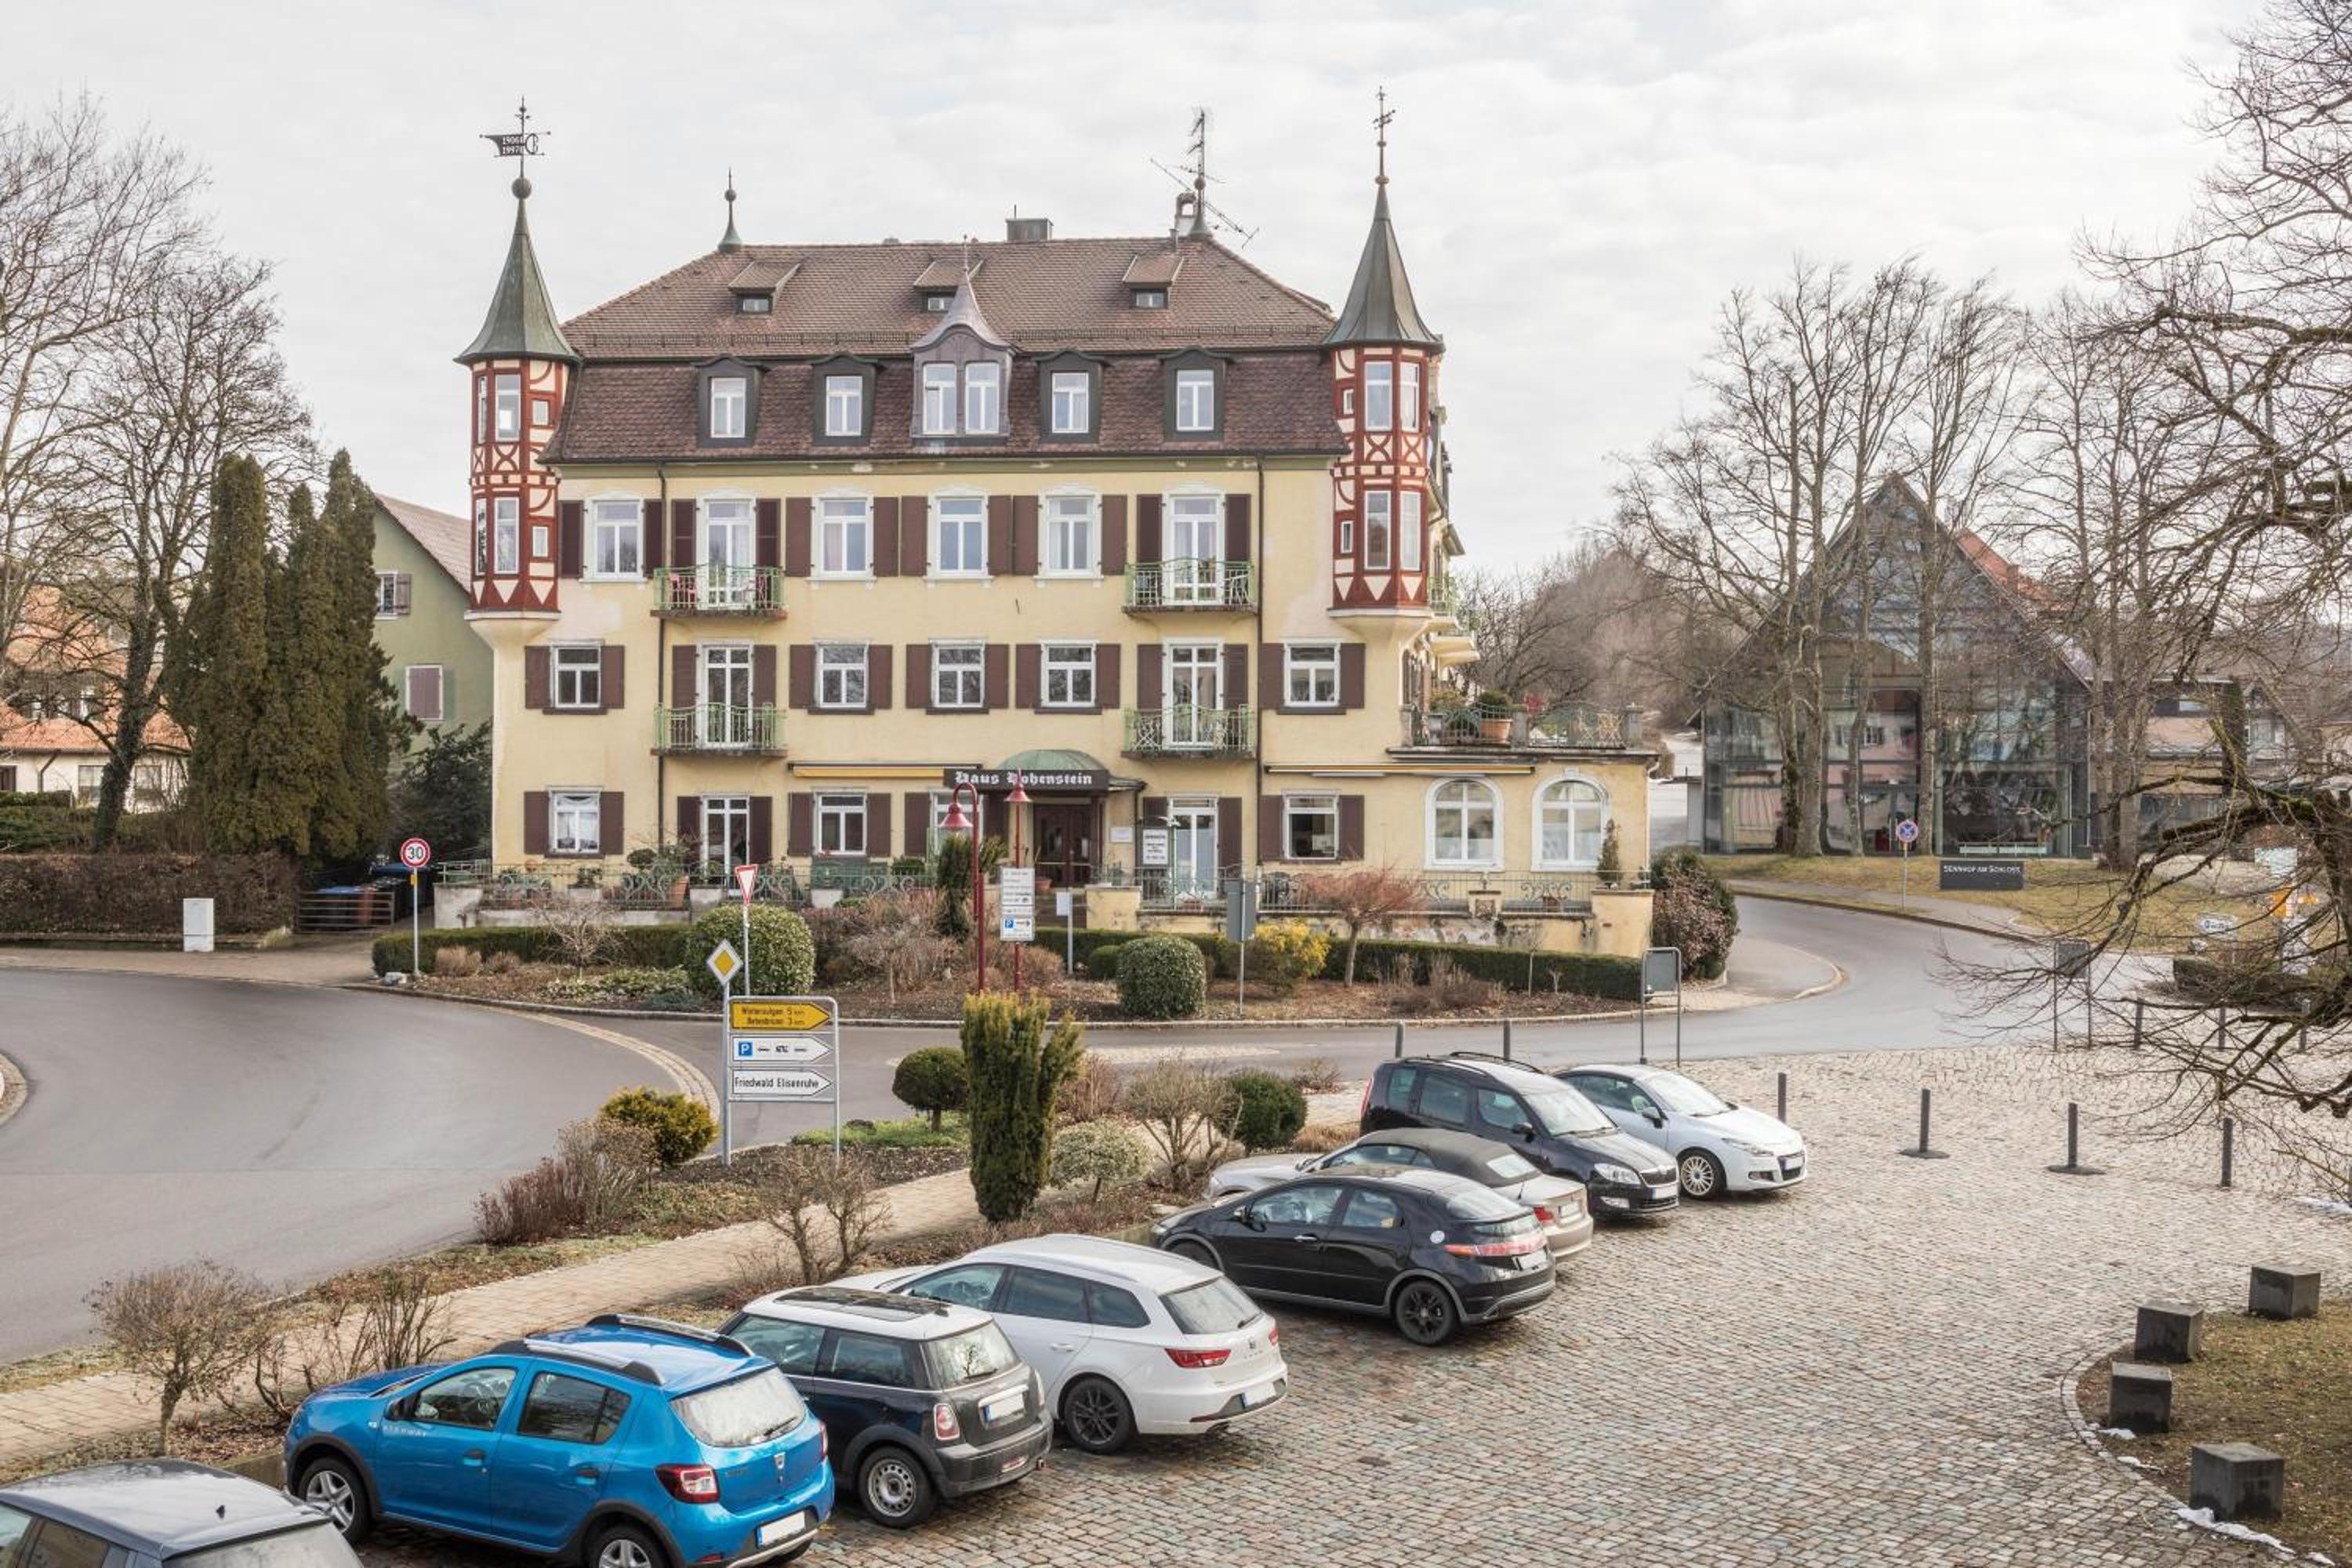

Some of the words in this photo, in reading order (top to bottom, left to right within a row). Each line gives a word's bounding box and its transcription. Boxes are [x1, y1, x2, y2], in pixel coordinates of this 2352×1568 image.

[955, 771, 1000, 784] Haus
[408, 847, 424, 859] 30
[735, 1077, 774, 1087] Friedwald
[777, 1078, 819, 1088] Elisenruhe
